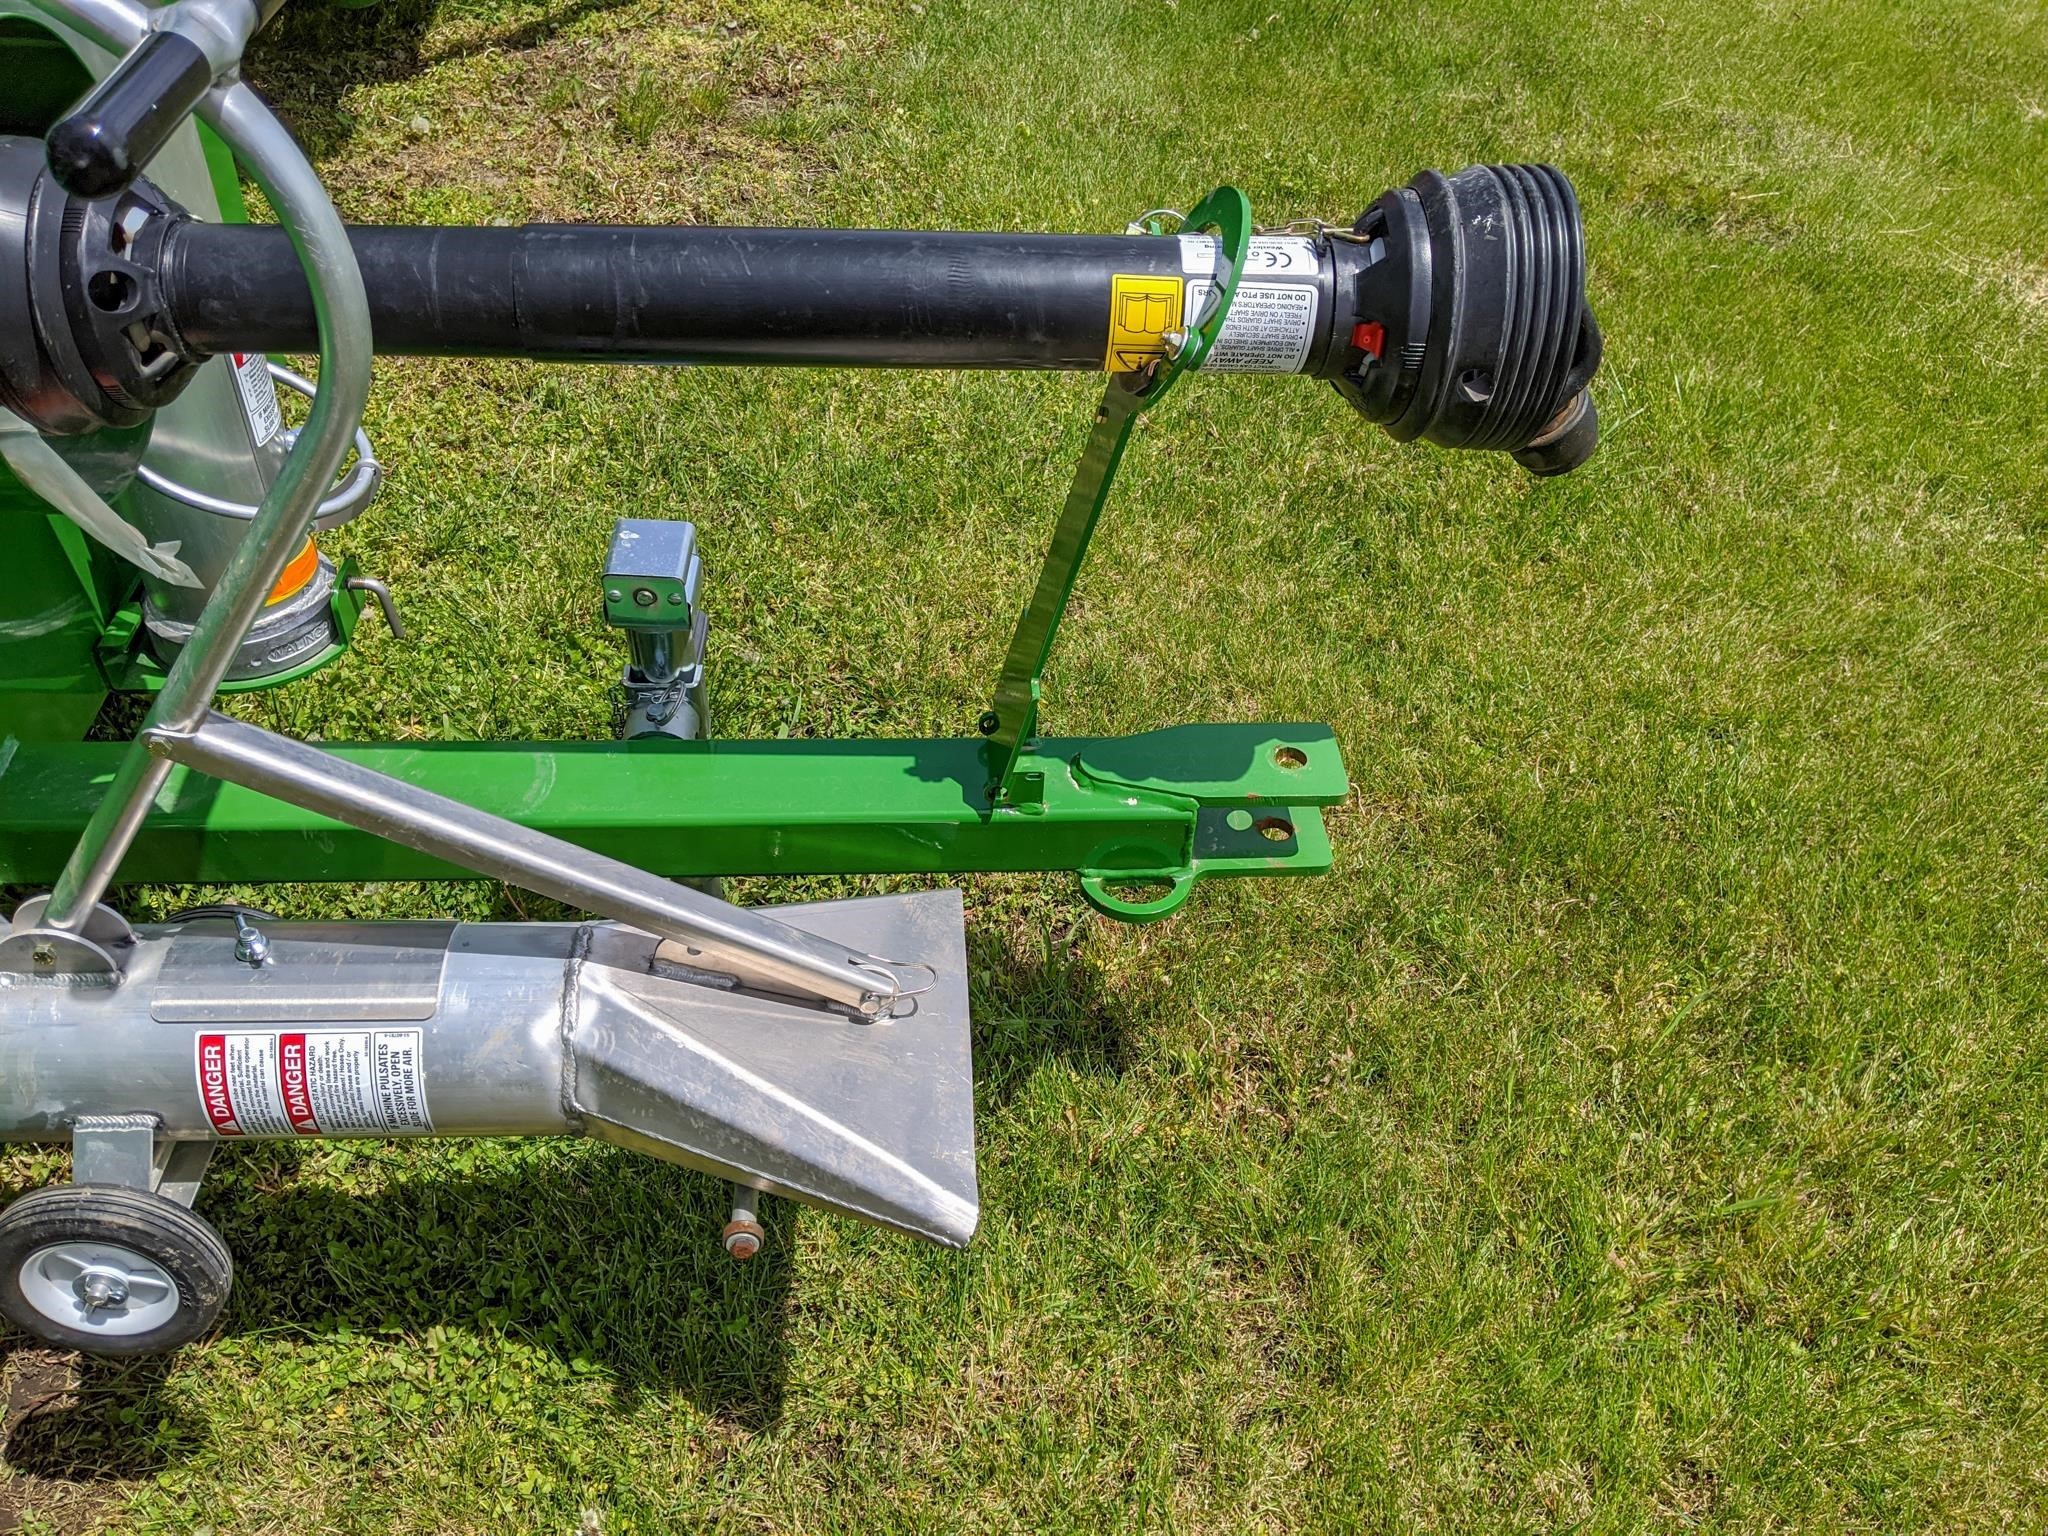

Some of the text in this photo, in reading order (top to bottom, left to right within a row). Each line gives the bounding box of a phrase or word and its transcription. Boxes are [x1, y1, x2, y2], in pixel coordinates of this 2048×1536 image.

[378, 1044, 390, 1090] PULSATES
[390, 1051, 401, 1077] OPEN
[204, 1045, 230, 1117] DANGER
[239, 1079, 247, 1101] material.
[260, 1080, 268, 1101] material
[284, 1044, 309, 1116] DANGER
[319, 1083, 328, 1097] injury
[340, 1077, 350, 1104] Equipment
[402, 1047, 422, 1127] SLIDE FOR MORE AIR.
[247, 1086, 256, 1108] removed
[310, 1078, 327, 1125] ELECTRO-STATIC
[322, 1098, 330, 1114] serious
[327, 1085, 337, 1109] conveying
[349, 1093, 358, 1108] plastic
[354, 1087, 362, 1100] those
[392, 1079, 410, 1125] EXCESSIVELY,
[344, 1106, 354, 1121] Original
[381, 1092, 398, 1124] MACHINE
